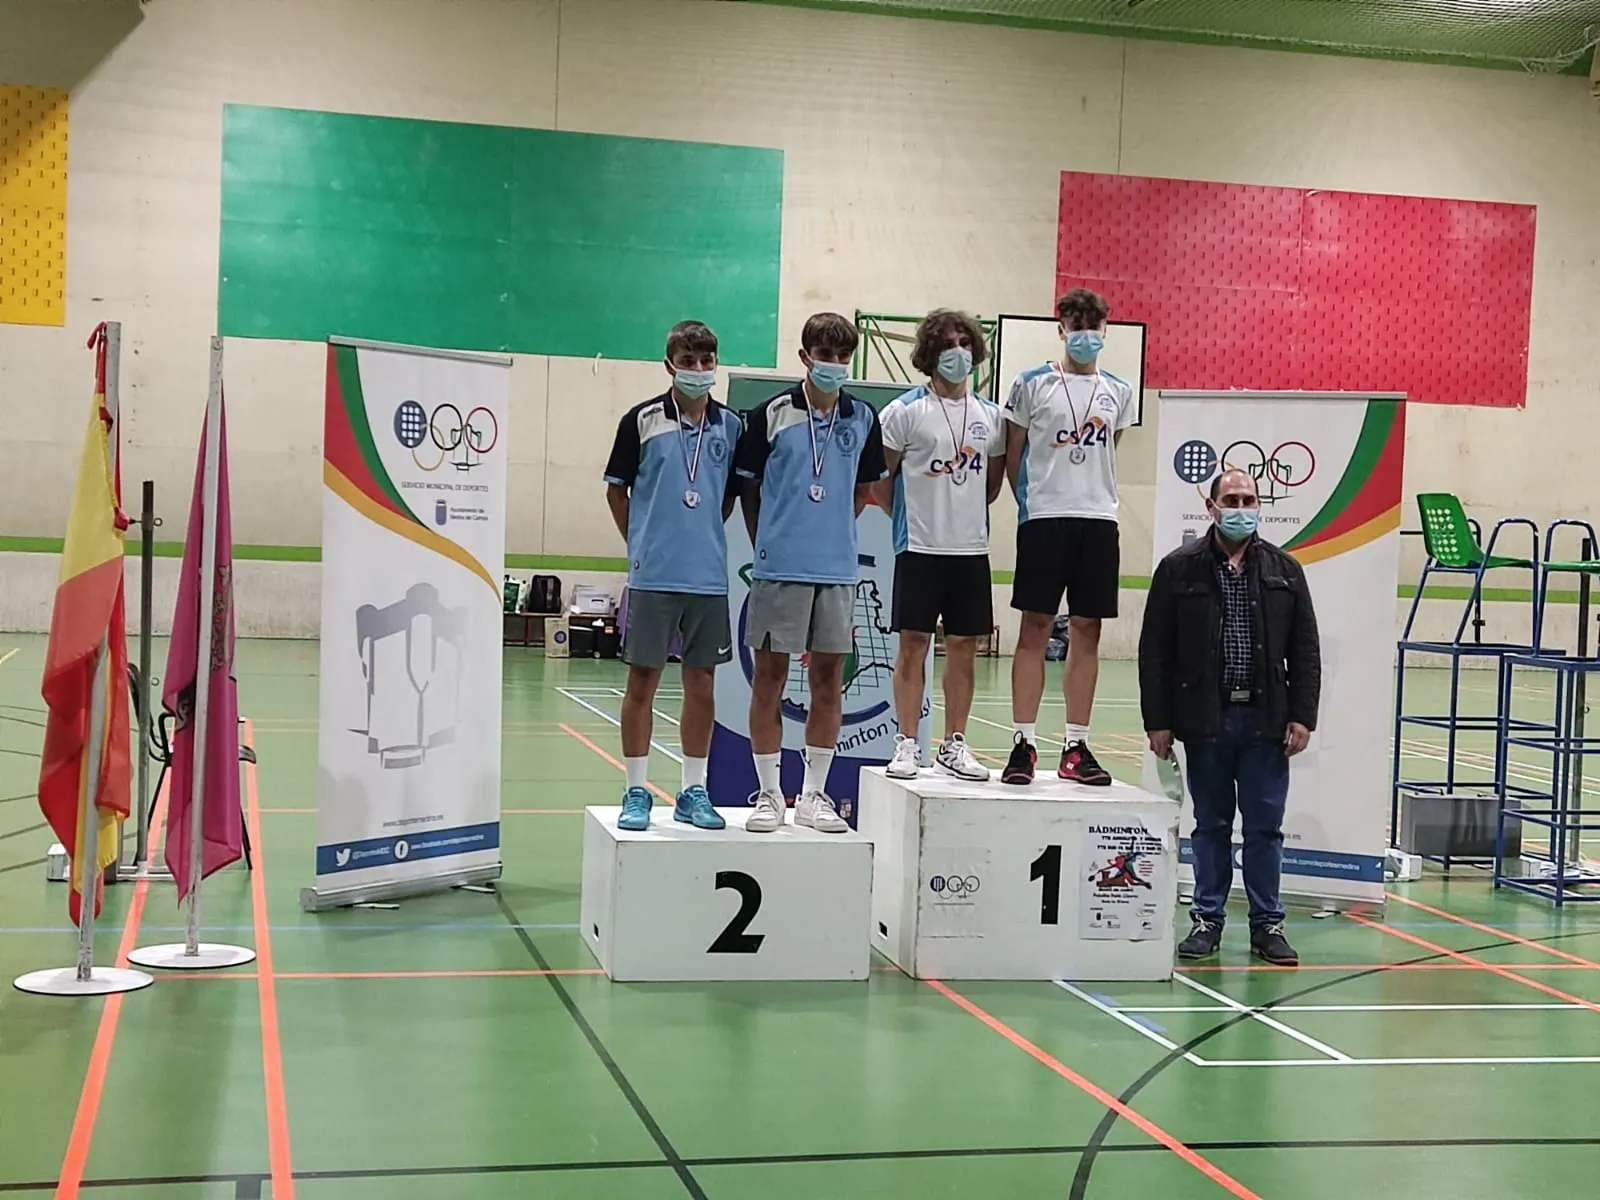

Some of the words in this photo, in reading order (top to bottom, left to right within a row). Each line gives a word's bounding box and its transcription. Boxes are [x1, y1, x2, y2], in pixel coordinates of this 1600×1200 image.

[1056, 421, 1107, 448] cs24
[1265, 516, 1301, 524] DEPORTES
[836, 723, 889, 753] minton
[1029, 844, 1062, 925] 1
[706, 870, 766, 953] 2
